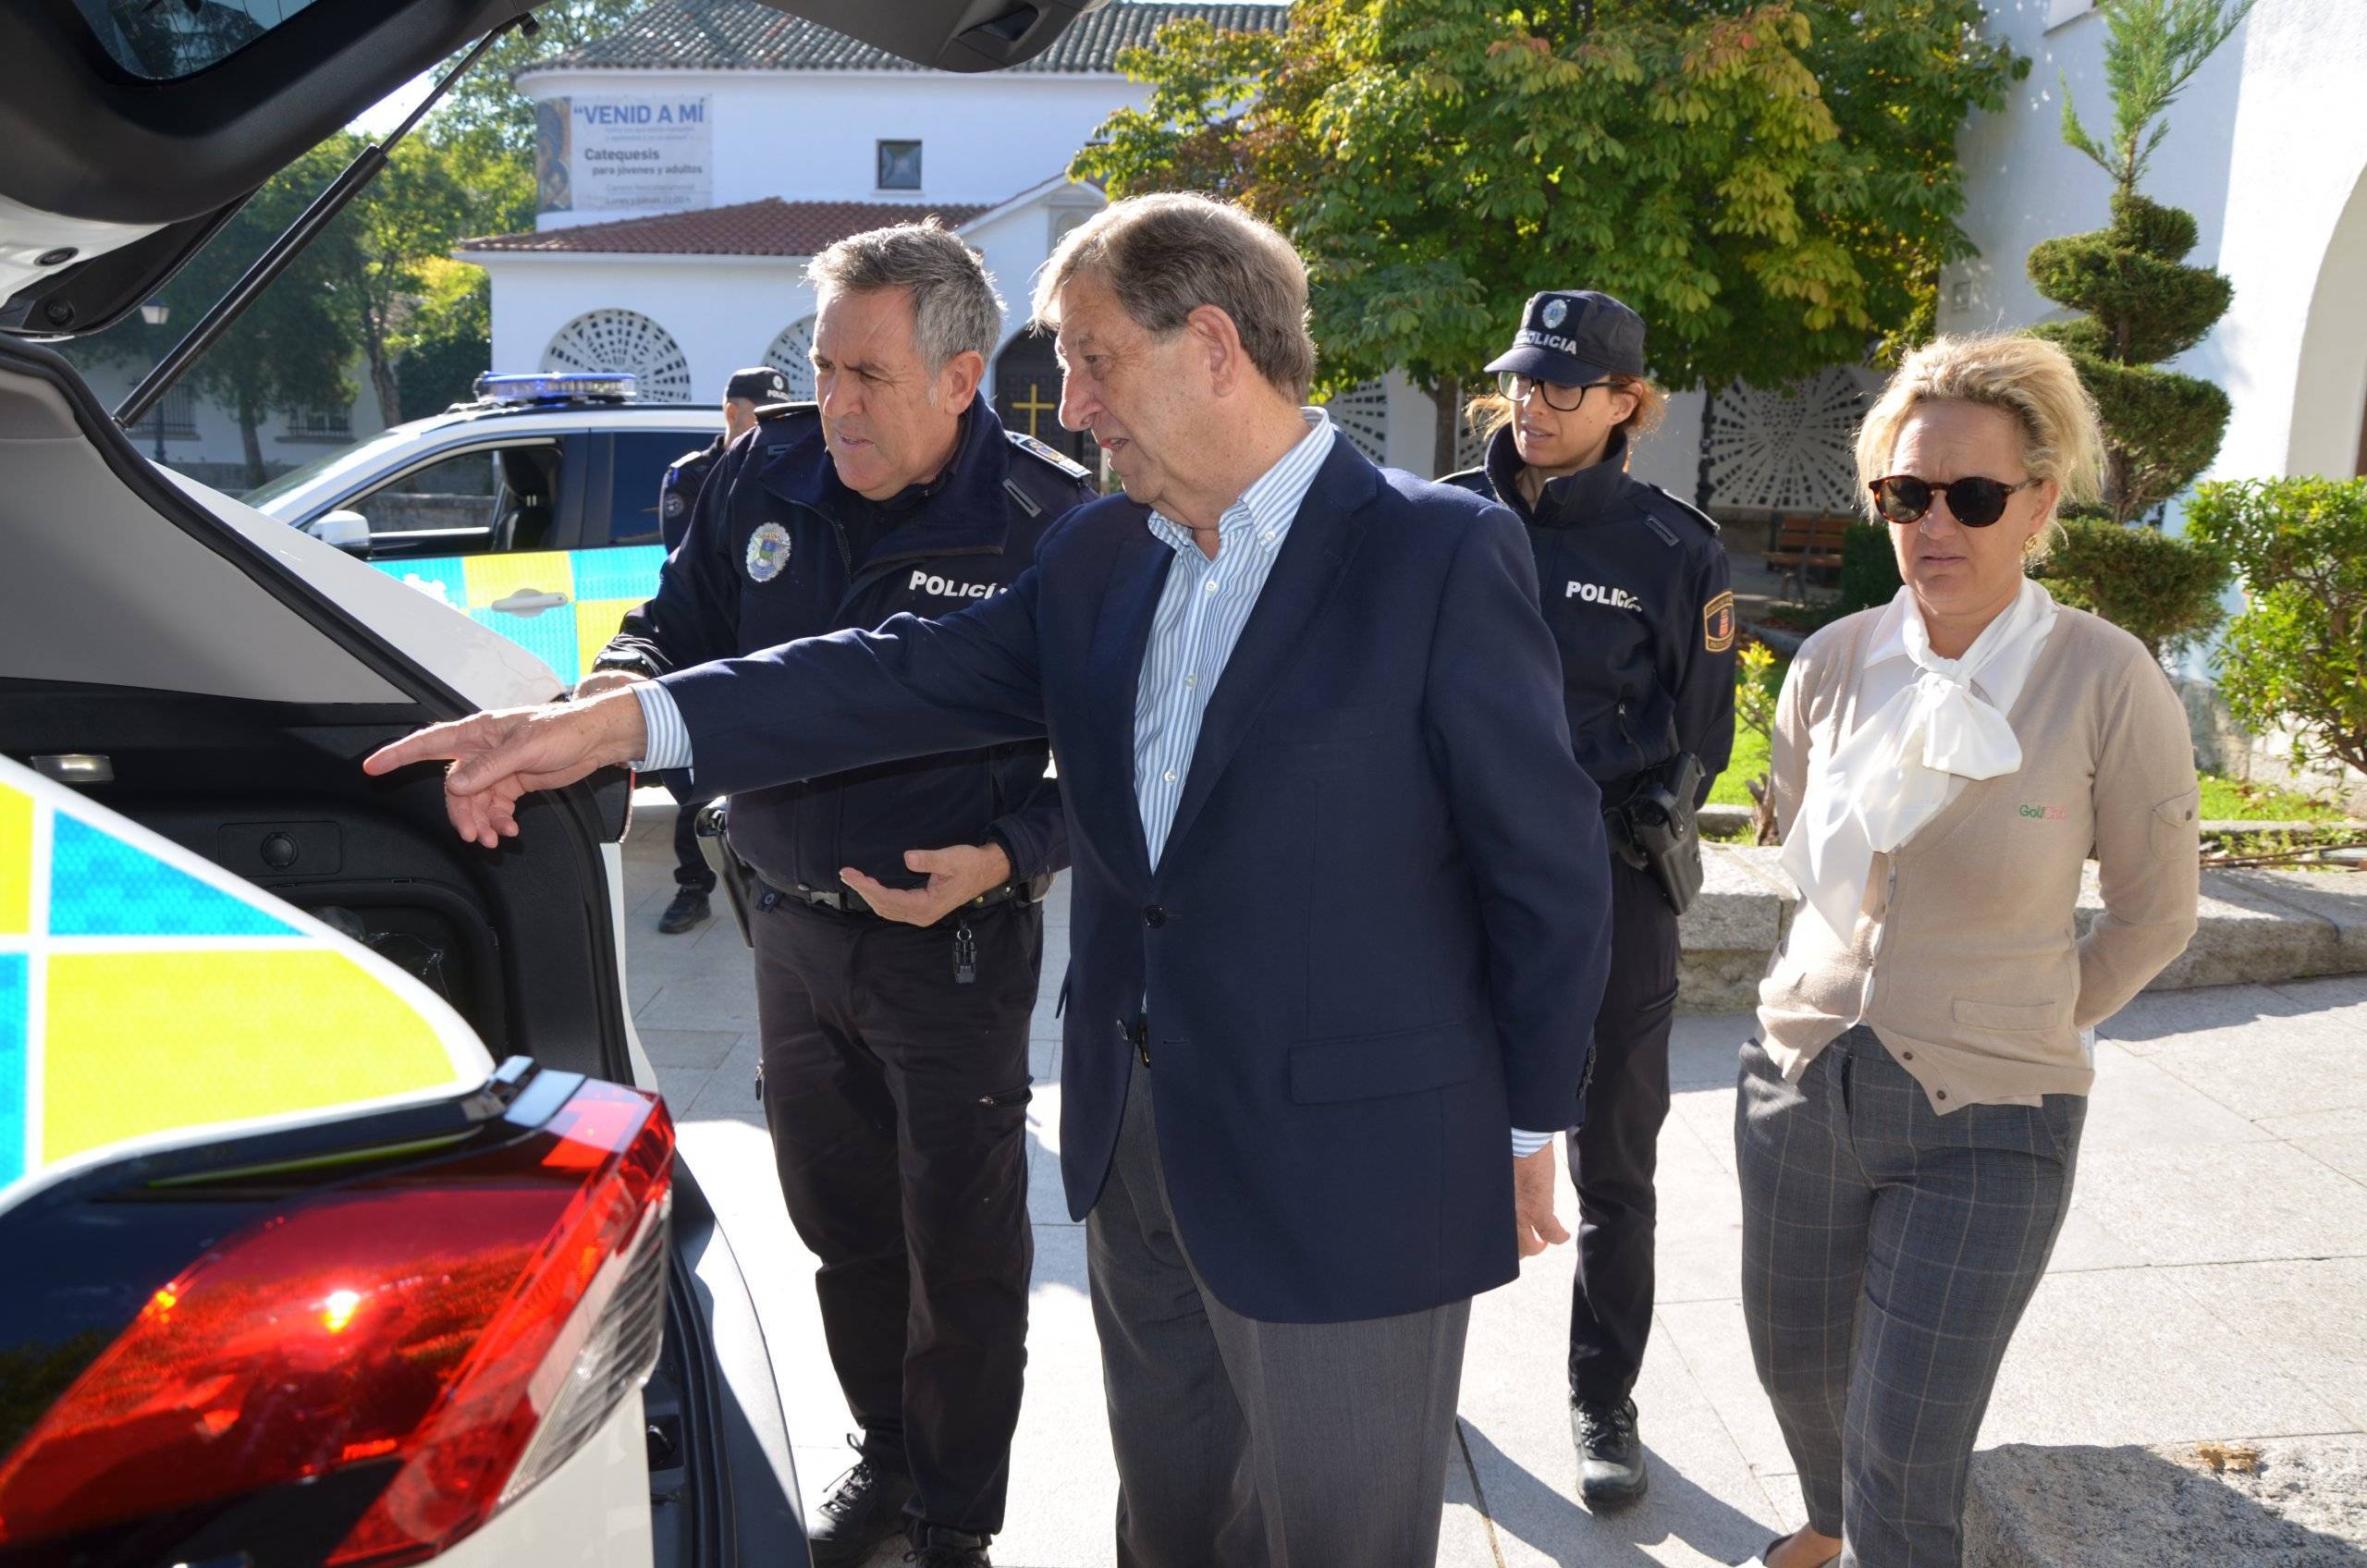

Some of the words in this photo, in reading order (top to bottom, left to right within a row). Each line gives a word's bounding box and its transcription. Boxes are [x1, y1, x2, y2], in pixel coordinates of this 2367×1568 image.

[656, 104, 673, 123] A
[679, 97, 705, 123] MÍ
[584, 147, 660, 162] Catequesis
[592, 166, 615, 177] para
[616, 165, 655, 177] jóvenes
[656, 167, 663, 176] y
[665, 164, 703, 174] adultos
[908, 570, 1008, 600] POLICÍ
